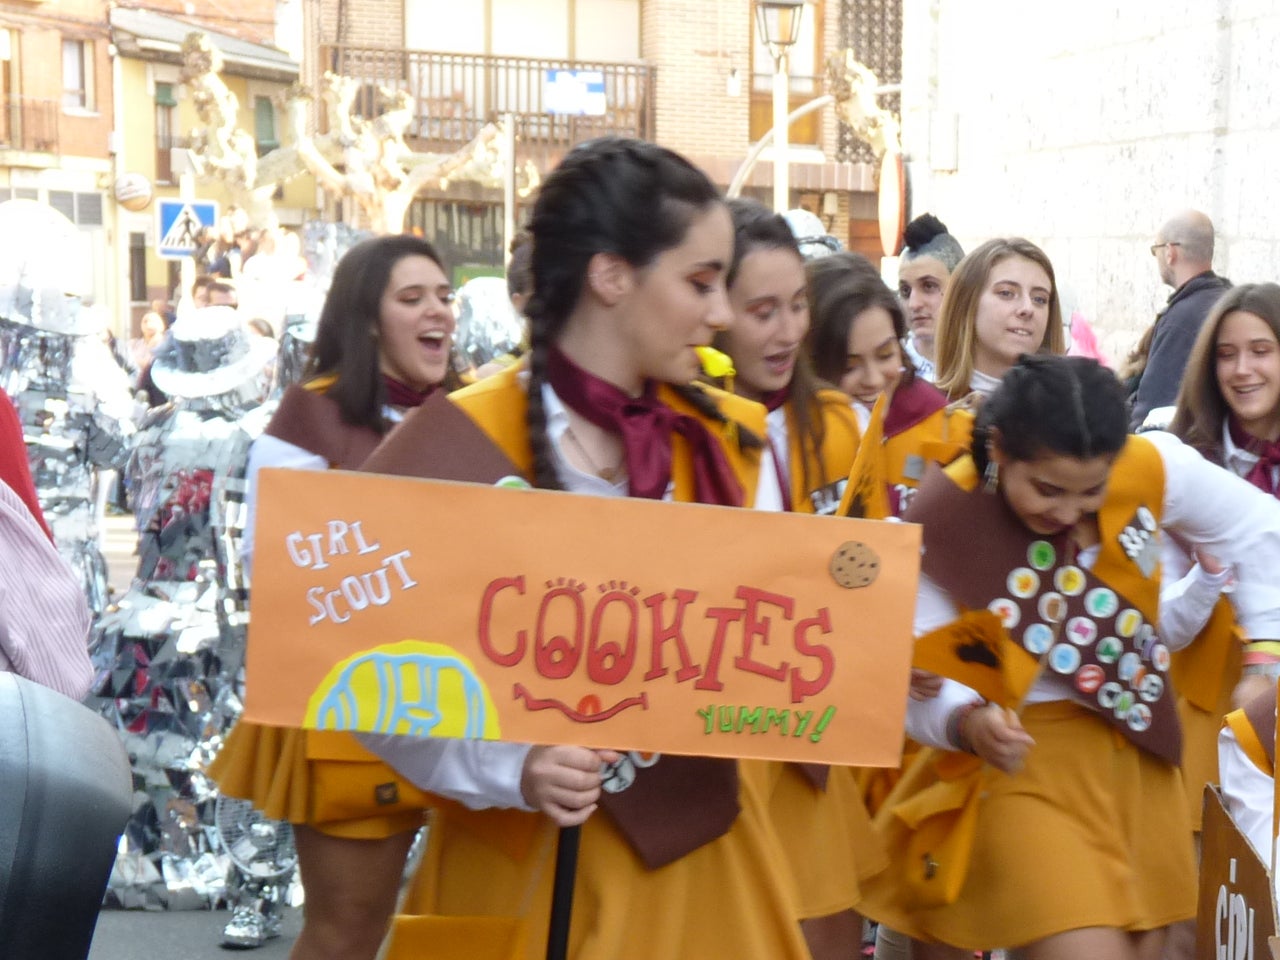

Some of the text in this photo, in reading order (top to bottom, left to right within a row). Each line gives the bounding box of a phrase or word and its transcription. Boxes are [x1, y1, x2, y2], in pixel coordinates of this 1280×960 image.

[286, 520, 379, 569] GIRL
[306, 550, 417, 626] SCOUT
[478, 575, 835, 703] COOKIES
[697, 704, 836, 743] YUMMY!
